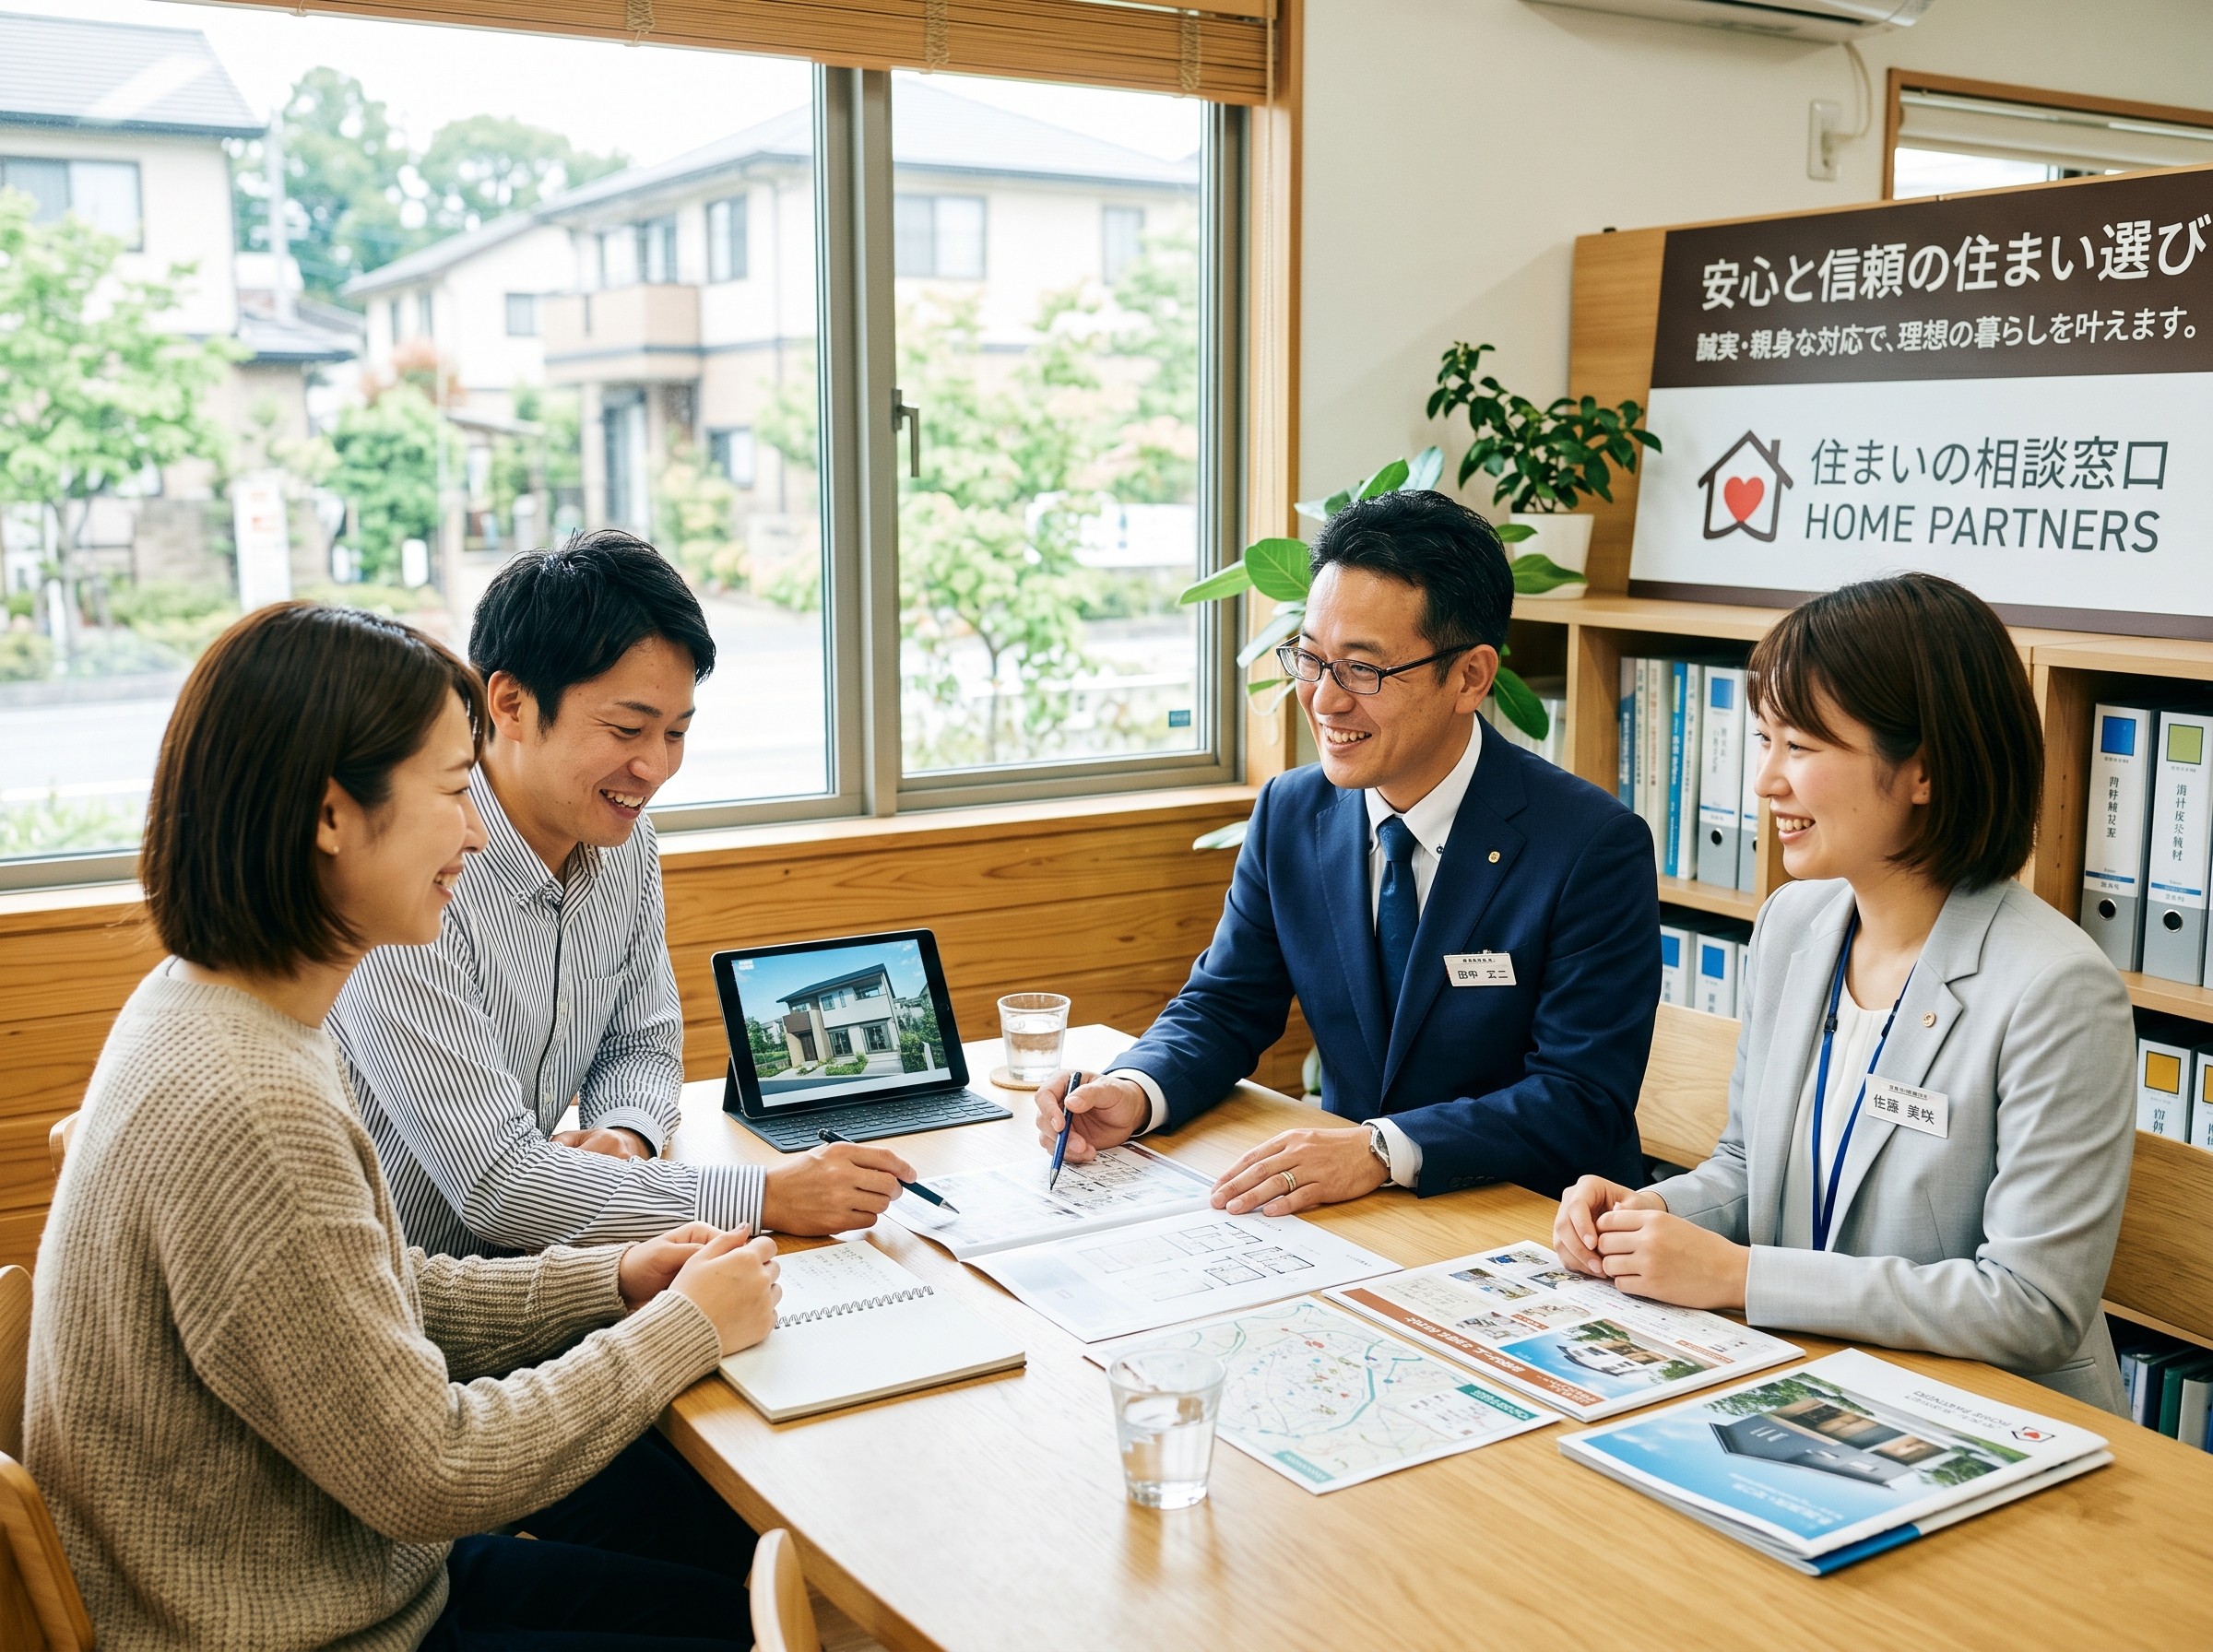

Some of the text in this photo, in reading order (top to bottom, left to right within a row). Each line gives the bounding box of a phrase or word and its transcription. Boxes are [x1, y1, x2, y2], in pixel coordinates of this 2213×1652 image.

[1702, 213, 2212, 311] 安心と信頼の住まい選び
[1696, 305, 2196, 361] 誠実・親身な対応で、理想の暮らしを叶えます。
[1811, 435, 2169, 490] 住まいの相談窓口
[1805, 502, 2160, 553] HOME PARTNERS
